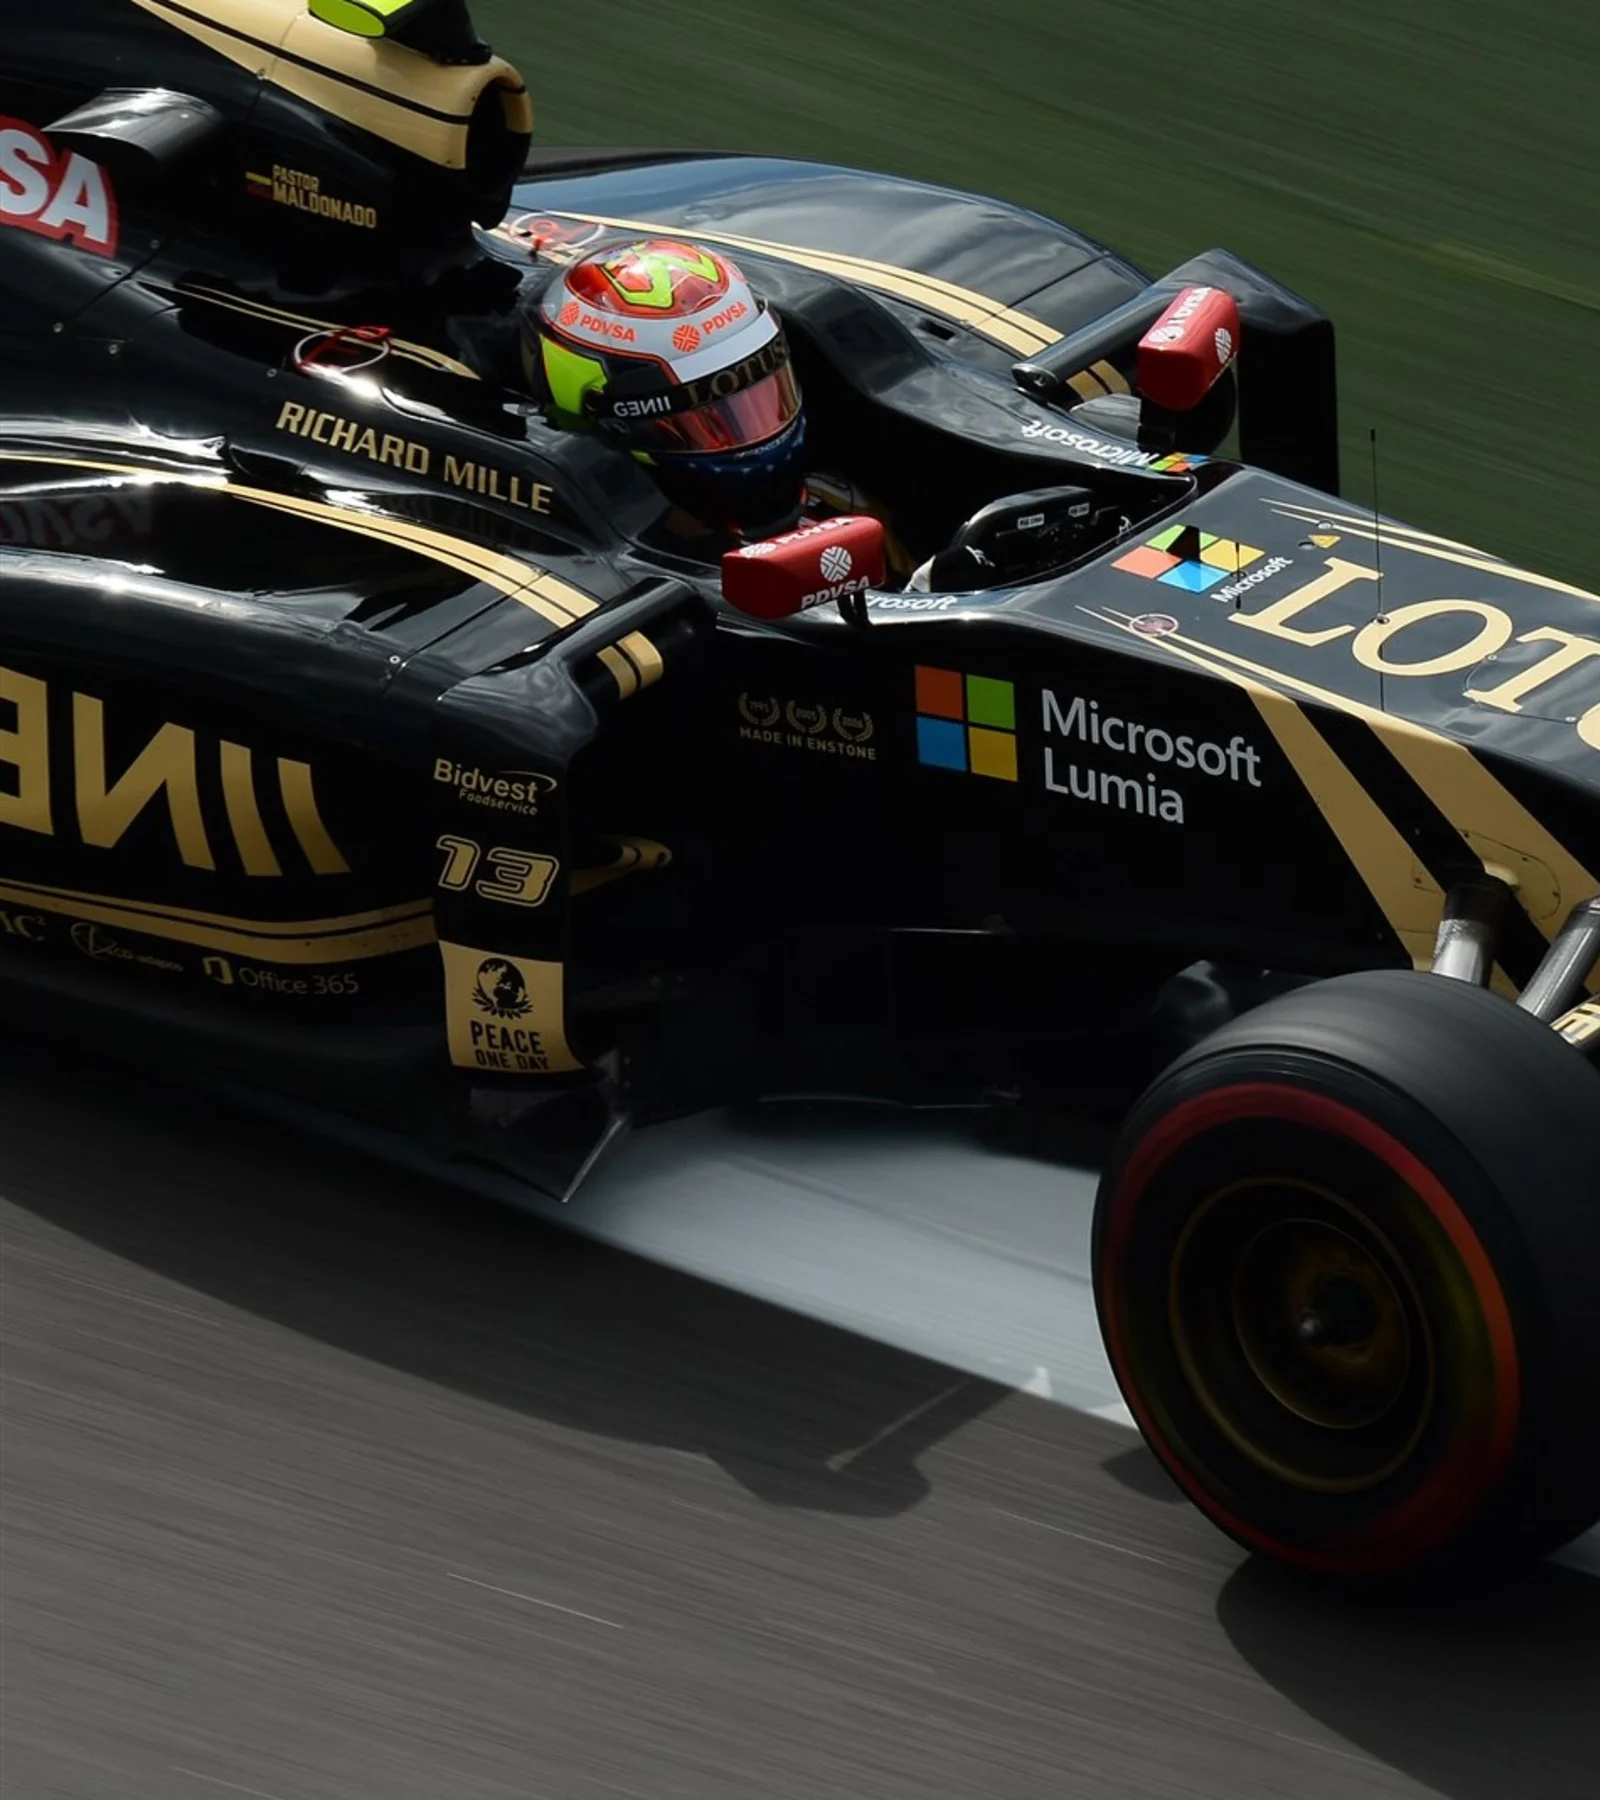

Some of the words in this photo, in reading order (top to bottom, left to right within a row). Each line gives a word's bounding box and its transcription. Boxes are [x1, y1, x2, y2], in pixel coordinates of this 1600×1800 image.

[273, 164, 319, 192] PASTOR
[273, 182, 377, 229] MALDONADO
[580, 315, 636, 343] PDVSA
[701, 302, 748, 335] PDVSA
[682, 337, 790, 408] LOTUS
[276, 401, 429, 475] RICHARD
[444, 454, 554, 514] MILLE
[1021, 420, 1161, 467] Microsoft
[801, 576, 869, 609] PDVSA
[1210, 556, 1293, 603] Microsoft
[865, 595, 958, 611] rosoft
[739, 726, 782, 744] MADE
[786, 733, 803, 748] IN
[807, 737, 876, 760] ENSTONE
[1041, 688, 1262, 787] Microsoft
[0, 665, 352, 877] ENII
[433, 757, 538, 803] Bidvest
[1044, 747, 1184, 824] Lumia
[458, 788, 538, 816] Foodservice
[437, 835, 560, 907] 13
[238, 966, 307, 995] Office
[313, 972, 359, 996] 365
[470, 1020, 544, 1054] PEACE
[475, 1049, 510, 1068] ONE
[516, 1054, 548, 1070] DAY
